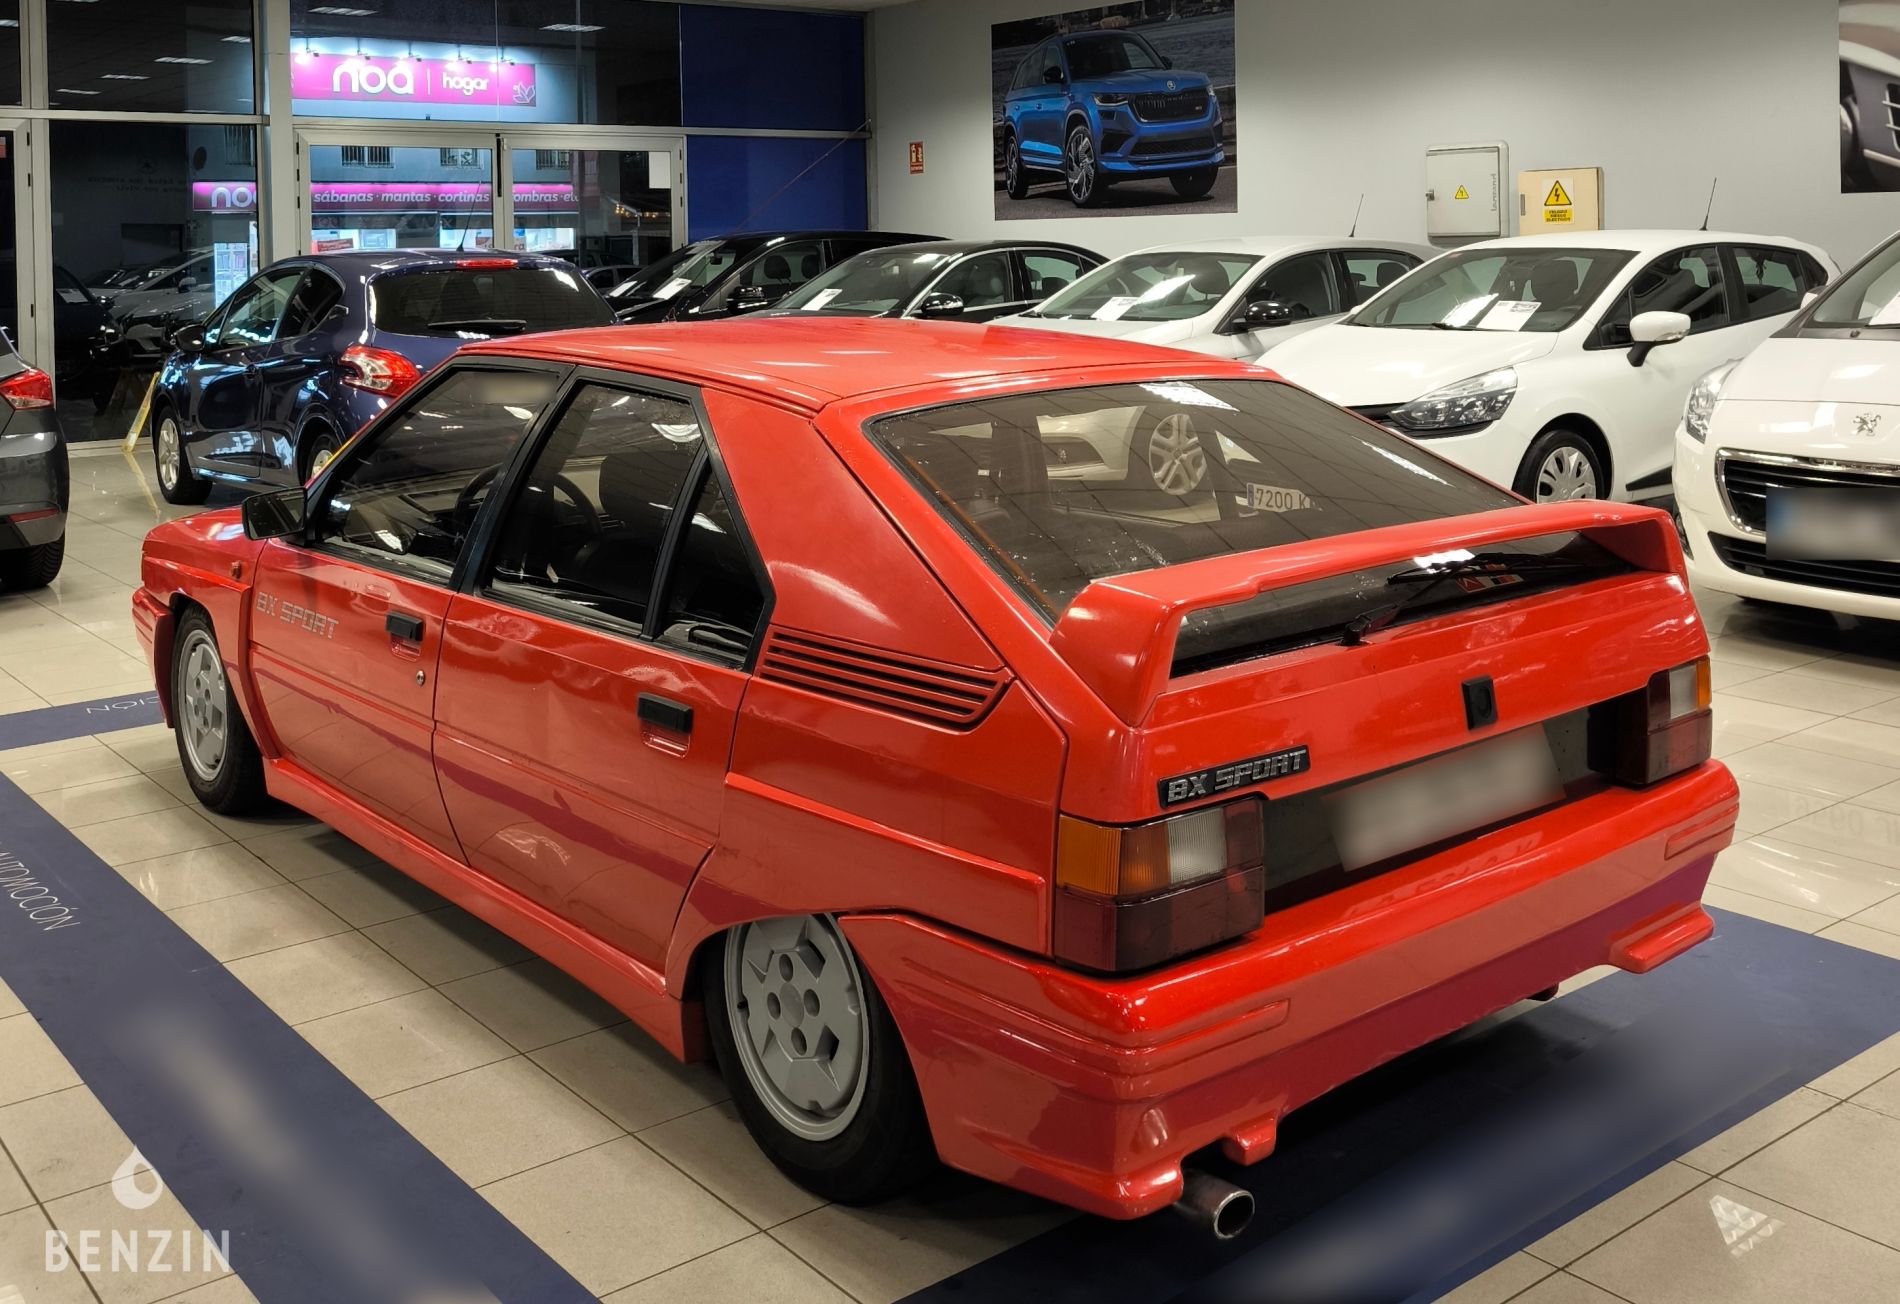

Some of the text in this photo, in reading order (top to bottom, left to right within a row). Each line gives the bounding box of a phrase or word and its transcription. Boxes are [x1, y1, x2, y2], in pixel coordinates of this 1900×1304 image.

[333, 62, 488, 95] noa hogar
[211, 187, 257, 208] no
[314, 190, 374, 203] sábanas
[381, 191, 431, 203] mantas
[438, 191, 489, 202] cortinas
[513, 190, 558, 202] ombras
[1256, 488, 1293, 510] 7200
[256, 591, 339, 640] BX SPORT
[1168, 749, 1307, 803] BX SPORT
[0, 851, 81, 931] TOMOCIÓN
